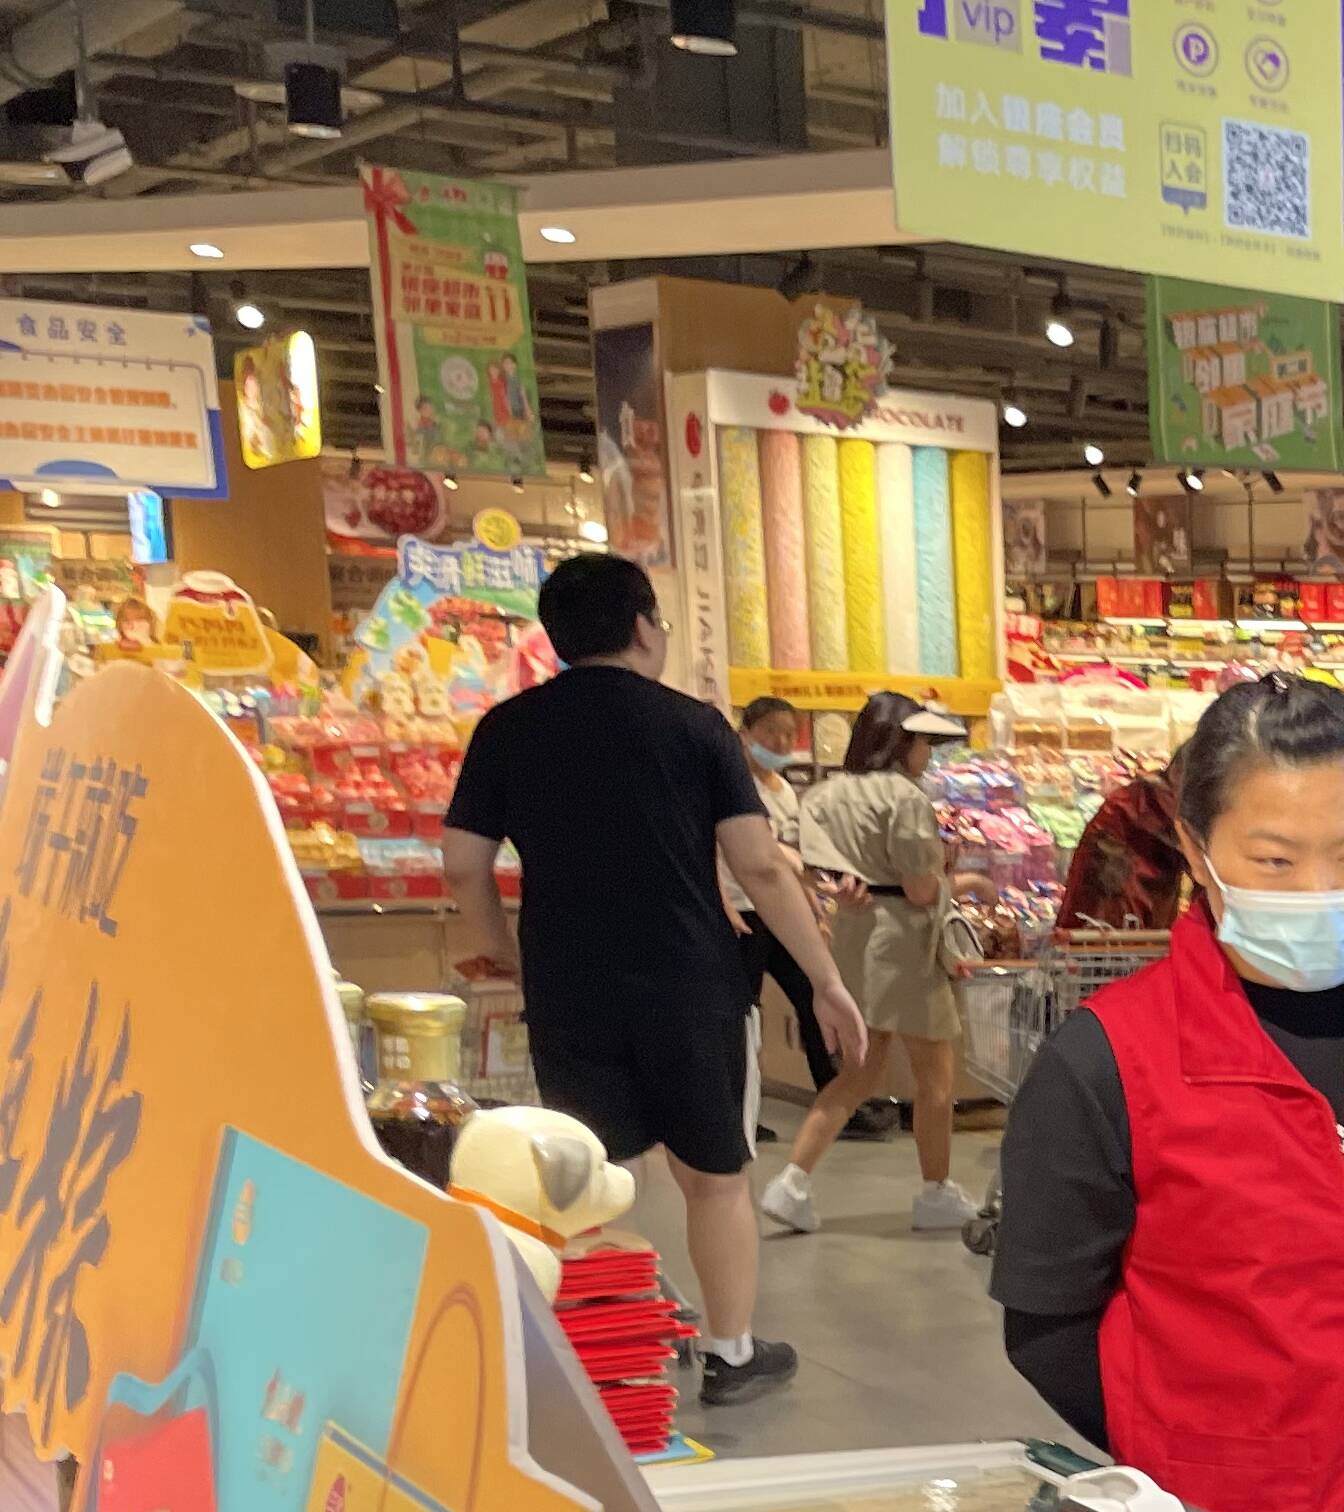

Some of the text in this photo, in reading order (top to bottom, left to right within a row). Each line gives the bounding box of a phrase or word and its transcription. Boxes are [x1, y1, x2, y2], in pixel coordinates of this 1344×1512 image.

[936, 82, 1127, 152] 加入银座会员
[1164, 157, 1202, 185] 入会
[17, 312, 128, 346] 食品安全
